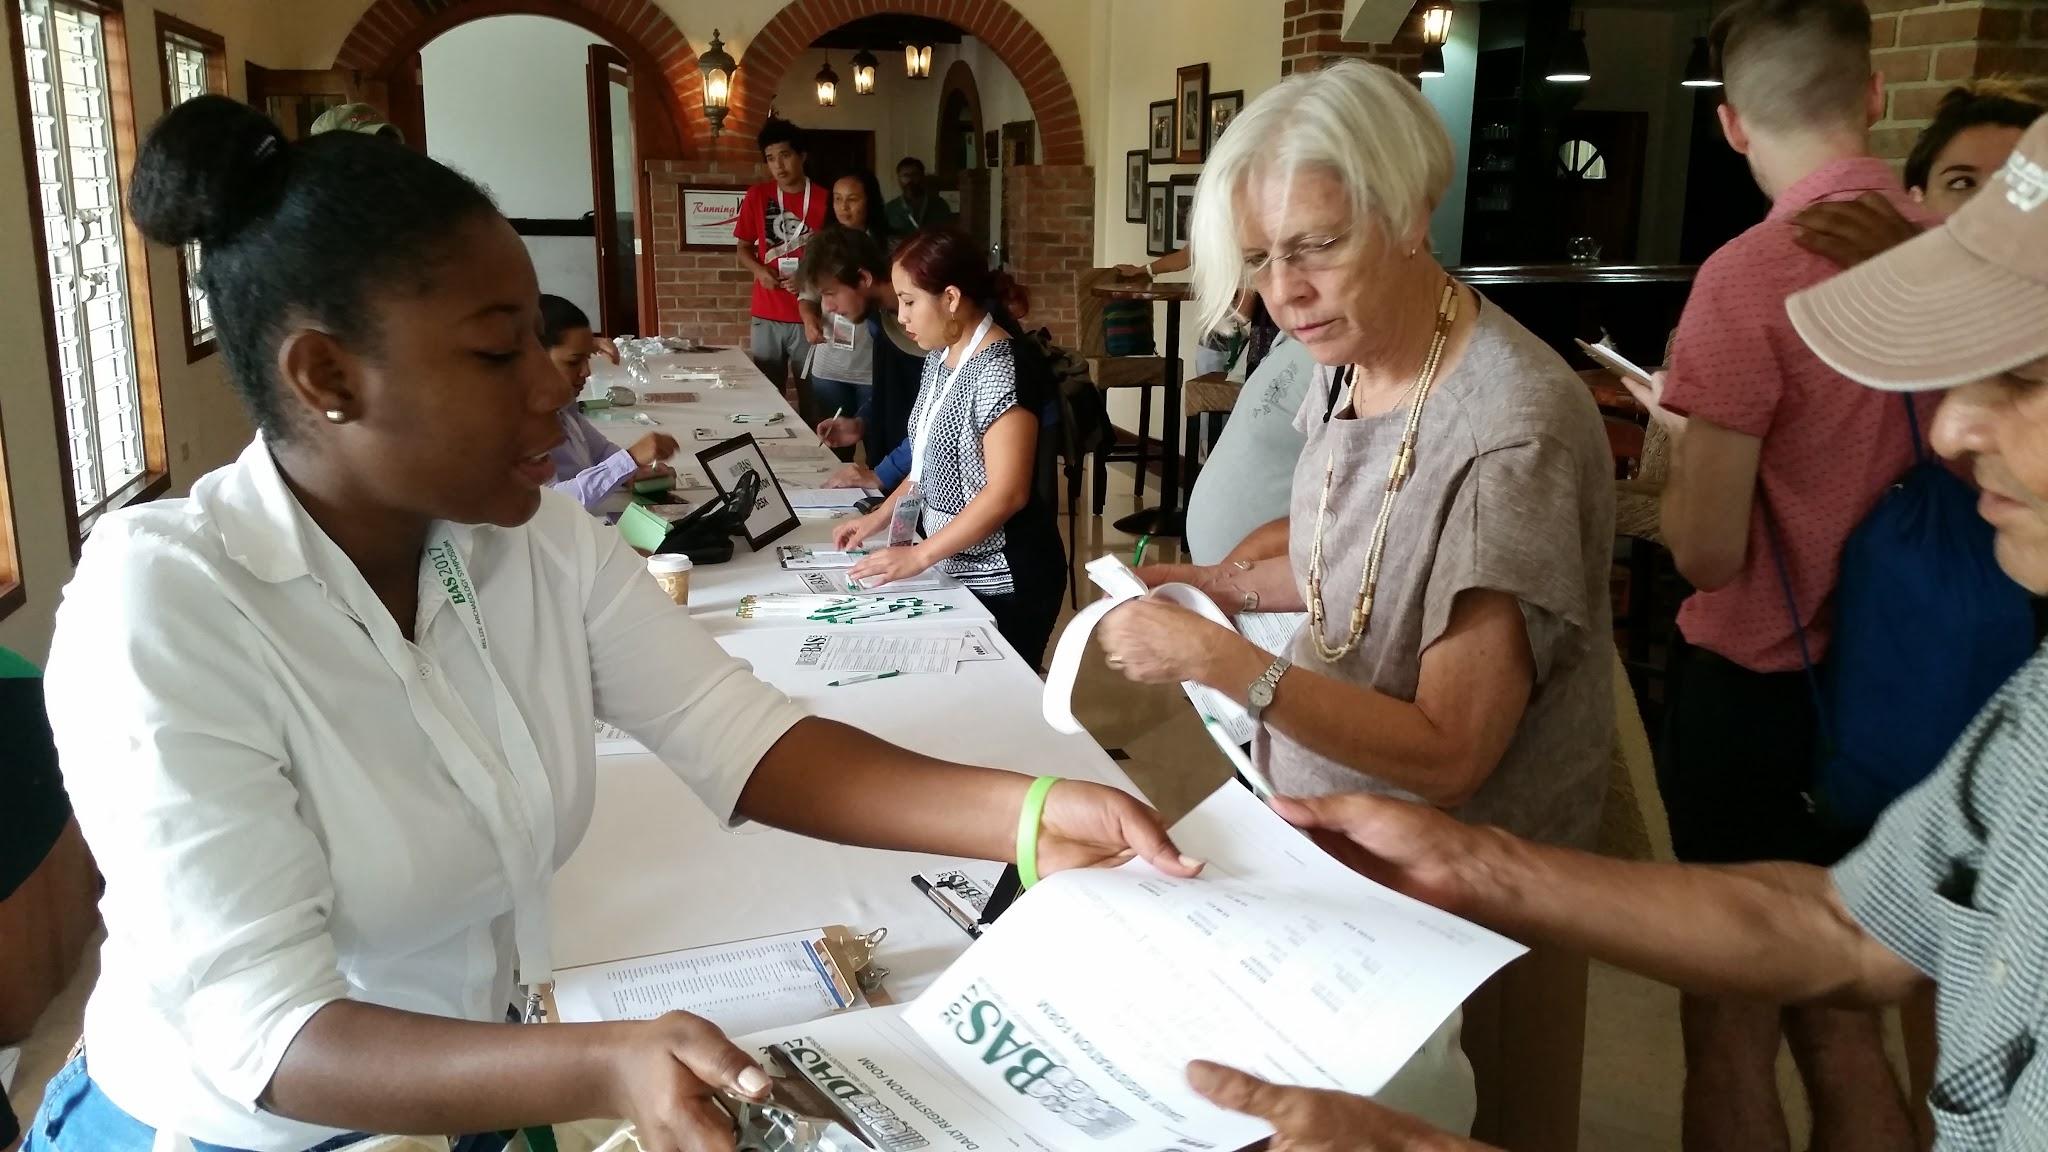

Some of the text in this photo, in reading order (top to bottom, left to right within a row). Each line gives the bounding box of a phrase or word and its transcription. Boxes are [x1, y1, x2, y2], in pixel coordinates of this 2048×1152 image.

[693, 202, 736, 216] Running
[428, 547, 466, 605] BAS 2017
[443, 539, 464, 578] SYMPOSIUM
[940, 984, 980, 1025] 2017
[1036, 1000, 1072, 1035] FORM
[956, 1000, 1056, 1095] BAS
[1073, 1032, 1150, 1102] REGISTRATION
[857, 1057, 889, 1083] FORM
[886, 1079, 952, 1129] REGISTRATION
[949, 1128, 979, 1151] DAILY
